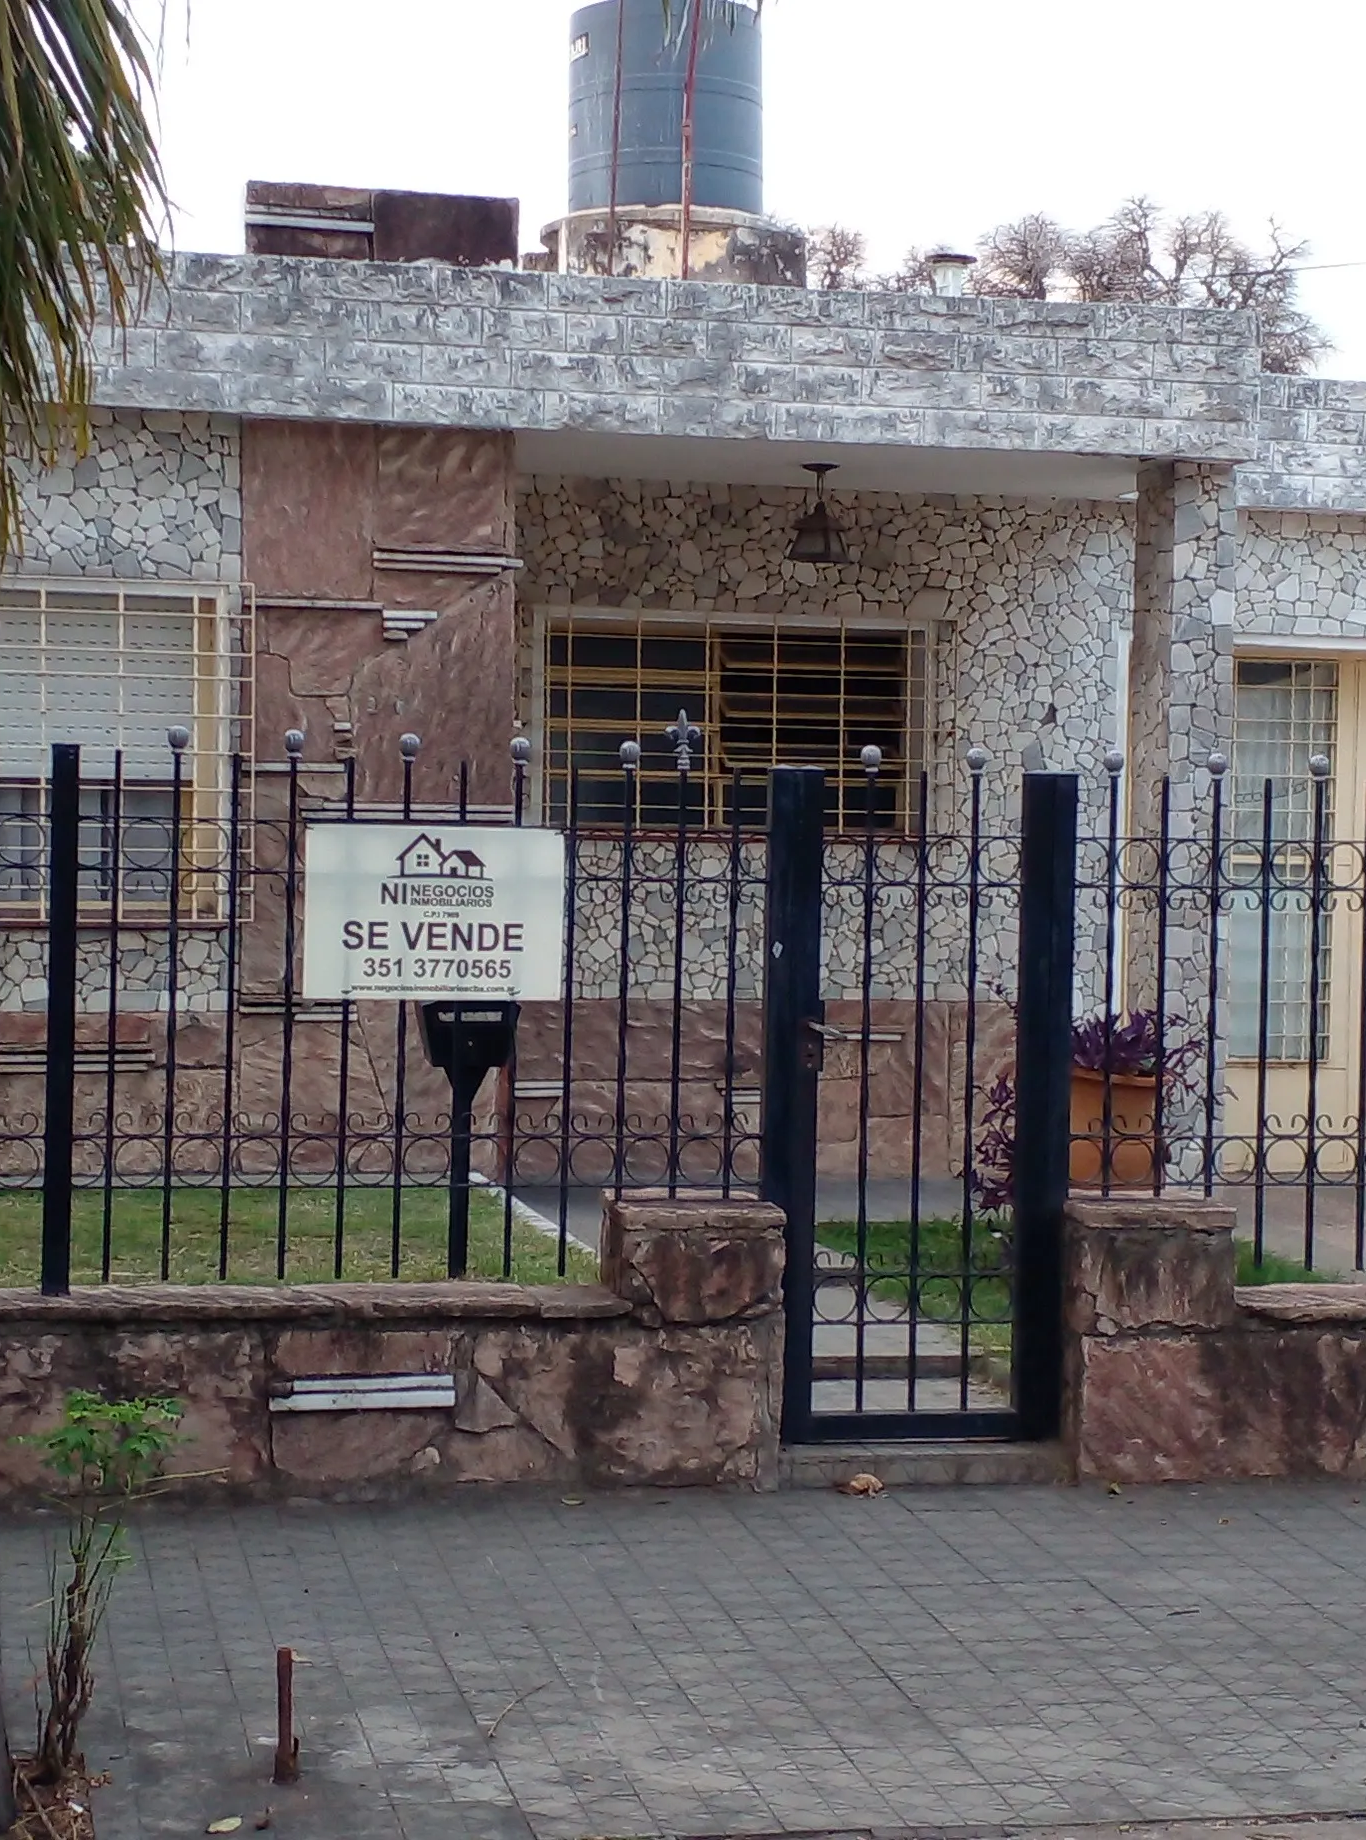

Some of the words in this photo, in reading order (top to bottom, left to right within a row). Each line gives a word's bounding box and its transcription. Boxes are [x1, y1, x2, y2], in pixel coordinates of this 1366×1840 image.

[380, 882, 407, 905] NI
[410, 884, 494, 898] NEGOCIOS
[410, 898, 492, 907] INMOBILIARIOS
[342, 921, 388, 950] SE
[401, 922, 523, 951] VENDE
[363, 958, 402, 977] 351
[414, 958, 511, 979] 3770565
